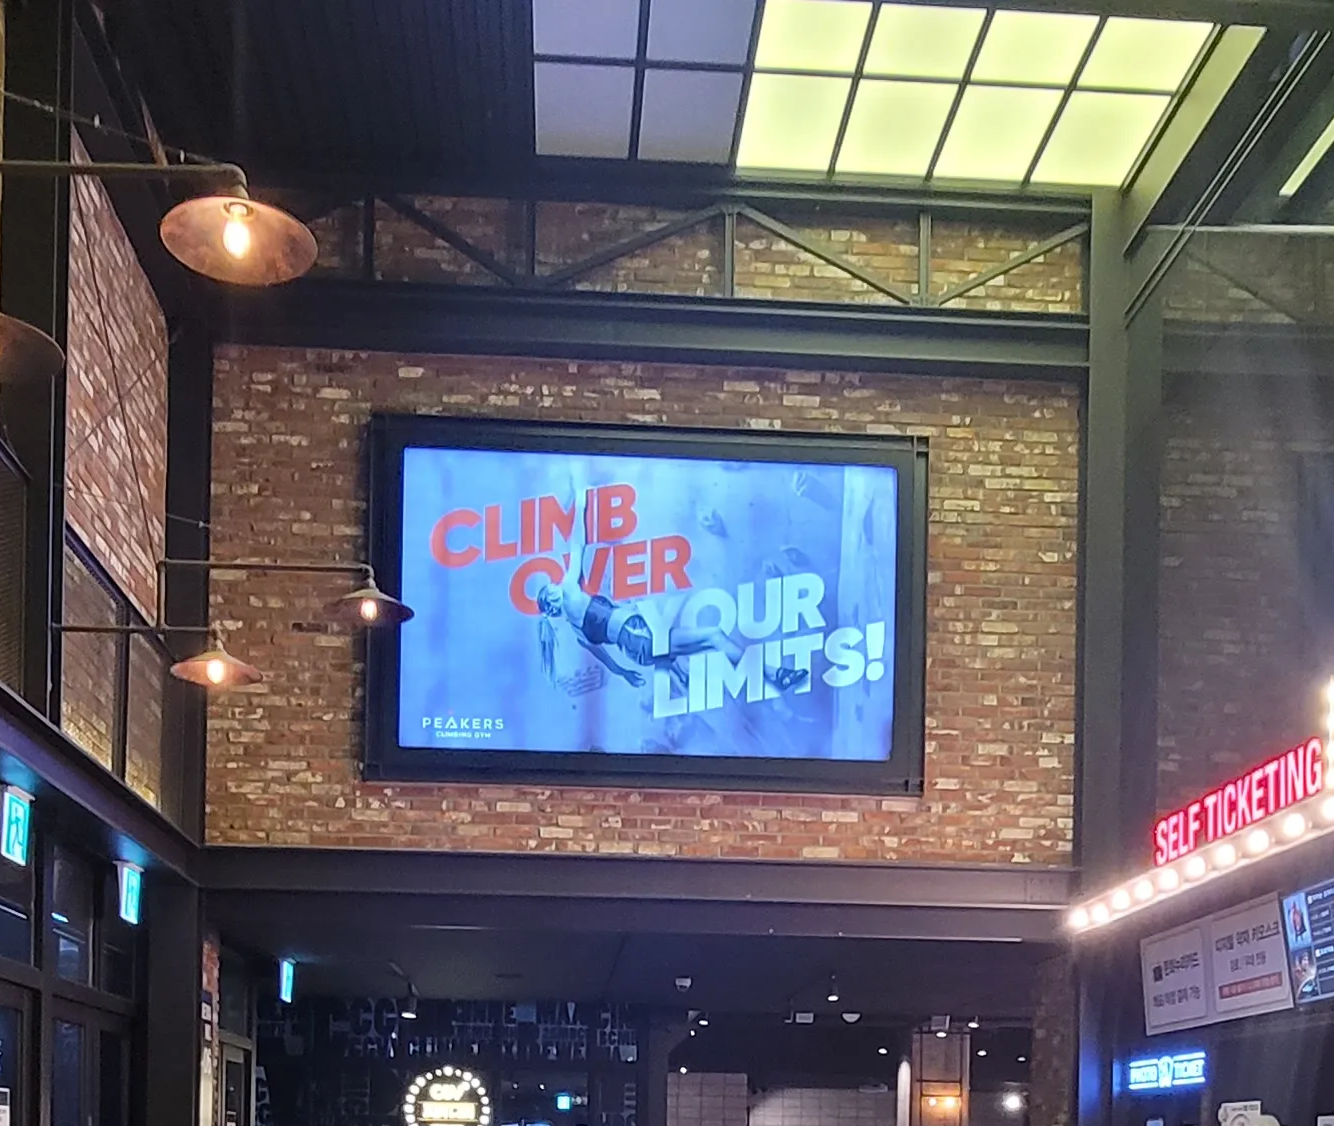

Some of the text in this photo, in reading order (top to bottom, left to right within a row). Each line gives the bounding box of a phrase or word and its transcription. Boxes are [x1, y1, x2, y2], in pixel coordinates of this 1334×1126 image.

[429, 483, 638, 569] CLIMB
[508, 534, 693, 616] OVER
[636, 572, 826, 656] YOUR
[422, 716, 504, 730] PEAKERS
[435, 730, 491, 739] CLIMBING GYM
[1154, 736, 1324, 867] SELF TICKETING
[1174, 1059, 1205, 1079] TICKET
